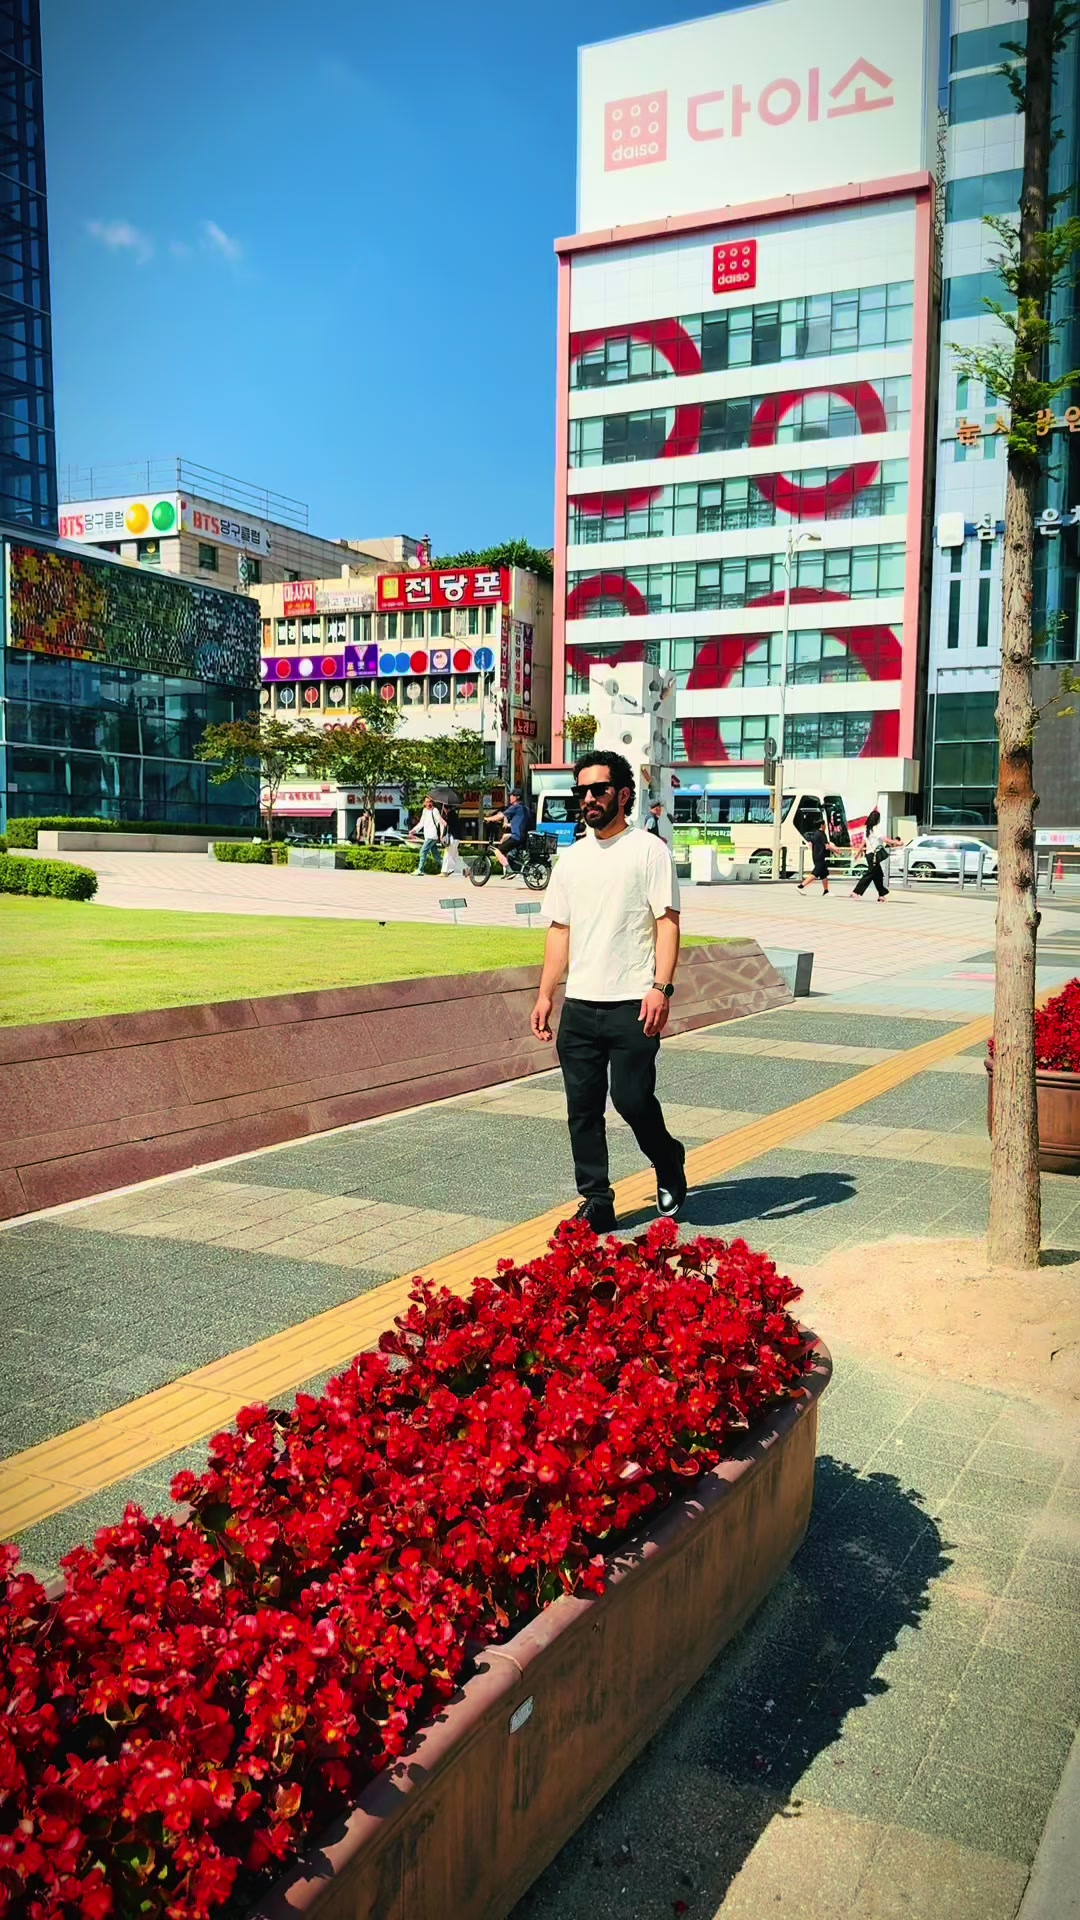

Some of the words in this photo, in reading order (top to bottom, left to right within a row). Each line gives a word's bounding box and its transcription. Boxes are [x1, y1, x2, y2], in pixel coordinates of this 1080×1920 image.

[687, 57, 894, 141] 다이소
[611, 141, 659, 161] daiso
[717, 271, 750, 285] daiso
[60, 515, 85, 536] BTS
[85, 511, 124, 531] 당구클럽
[193, 510, 220, 535] BTS
[220, 519, 260, 545] 당구클럽
[284, 584, 313, 602] 마사지
[405, 571, 501, 603] 전당포
